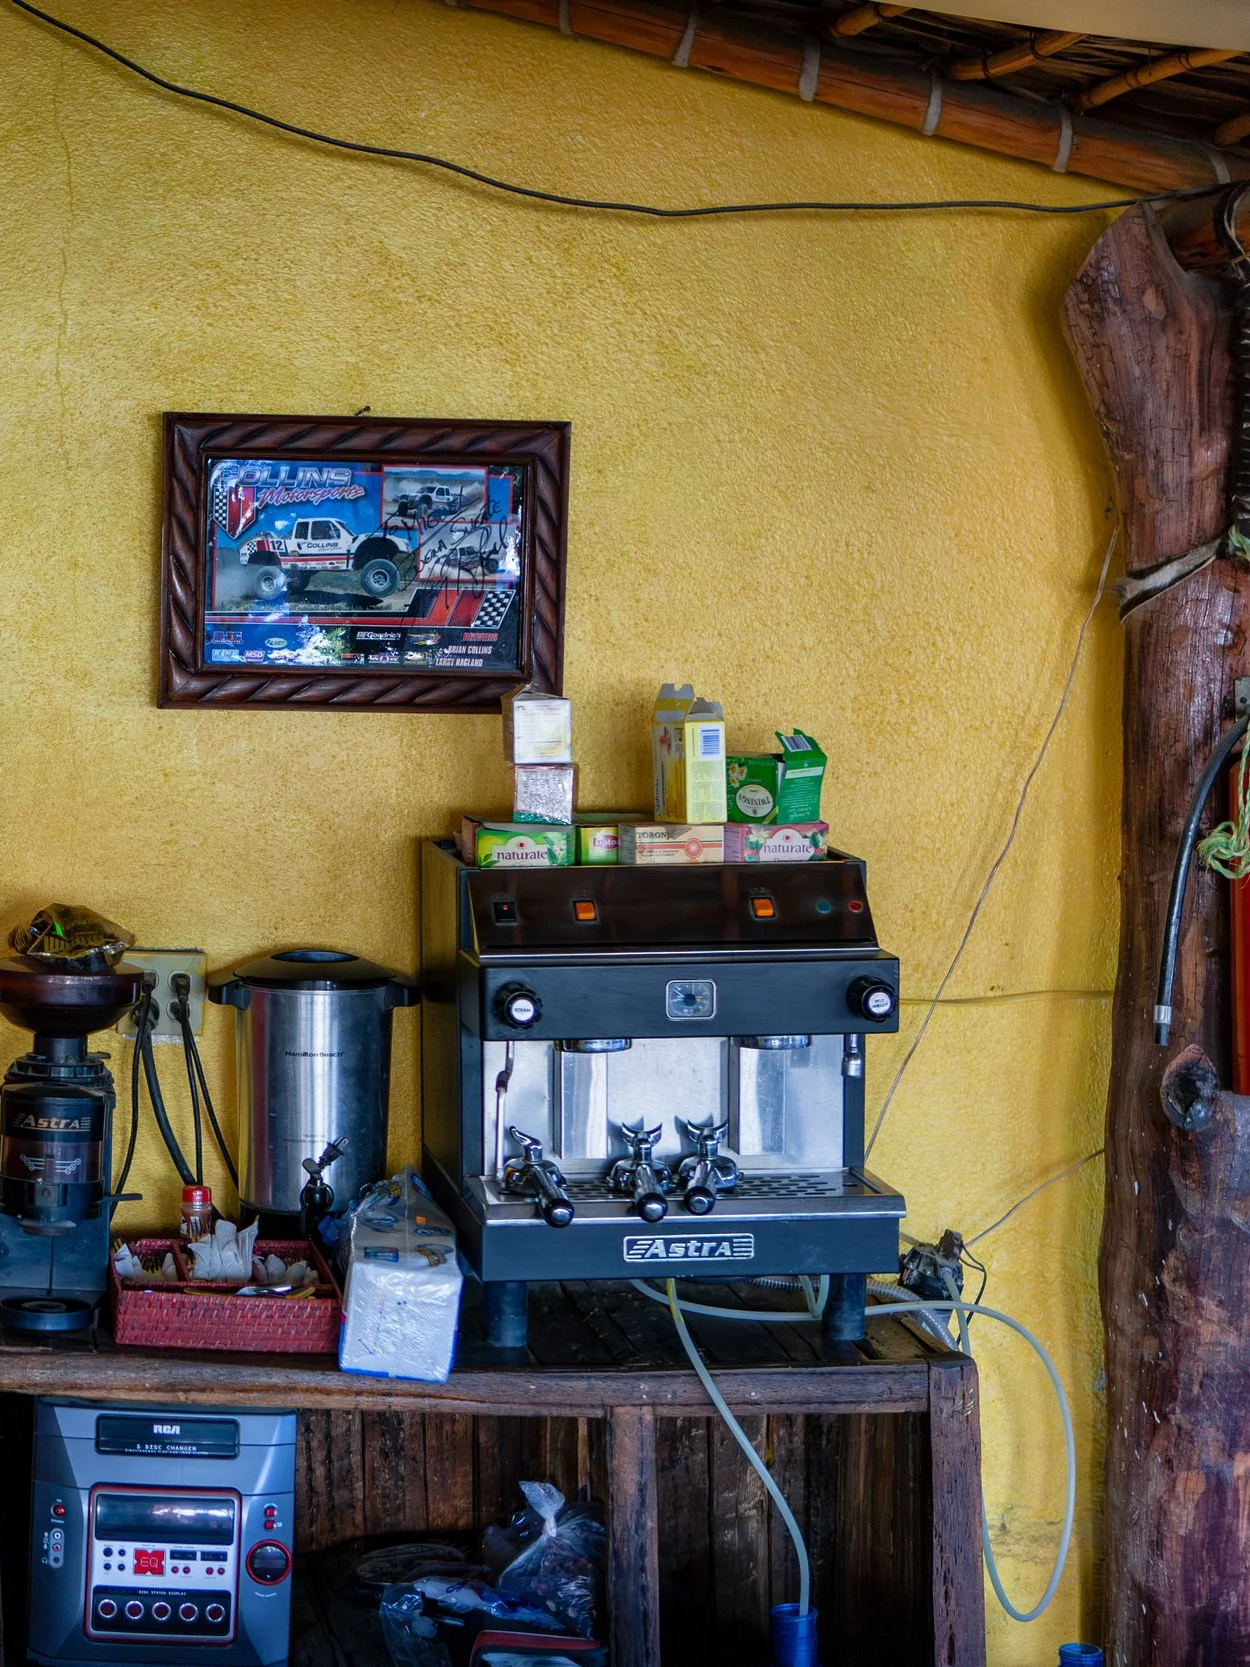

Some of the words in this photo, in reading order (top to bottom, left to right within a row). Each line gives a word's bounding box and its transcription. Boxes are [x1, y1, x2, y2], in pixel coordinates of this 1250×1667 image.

[257, 484, 365, 510] Motorsports
[269, 540, 284, 551] 12
[448, 646, 467, 654] BRIAN
[468, 646, 492, 654] COLLINS
[436, 657, 454, 666] LARRY
[738, 793, 771, 807] TWININGS
[636, 831, 670, 840] TORONJ
[593, 836, 618, 849] Lipto
[285, 1050, 318, 1058] Hamilton
[153, 1424, 181, 1435] RCA
[140, 1556, 159, 1569] EQ
